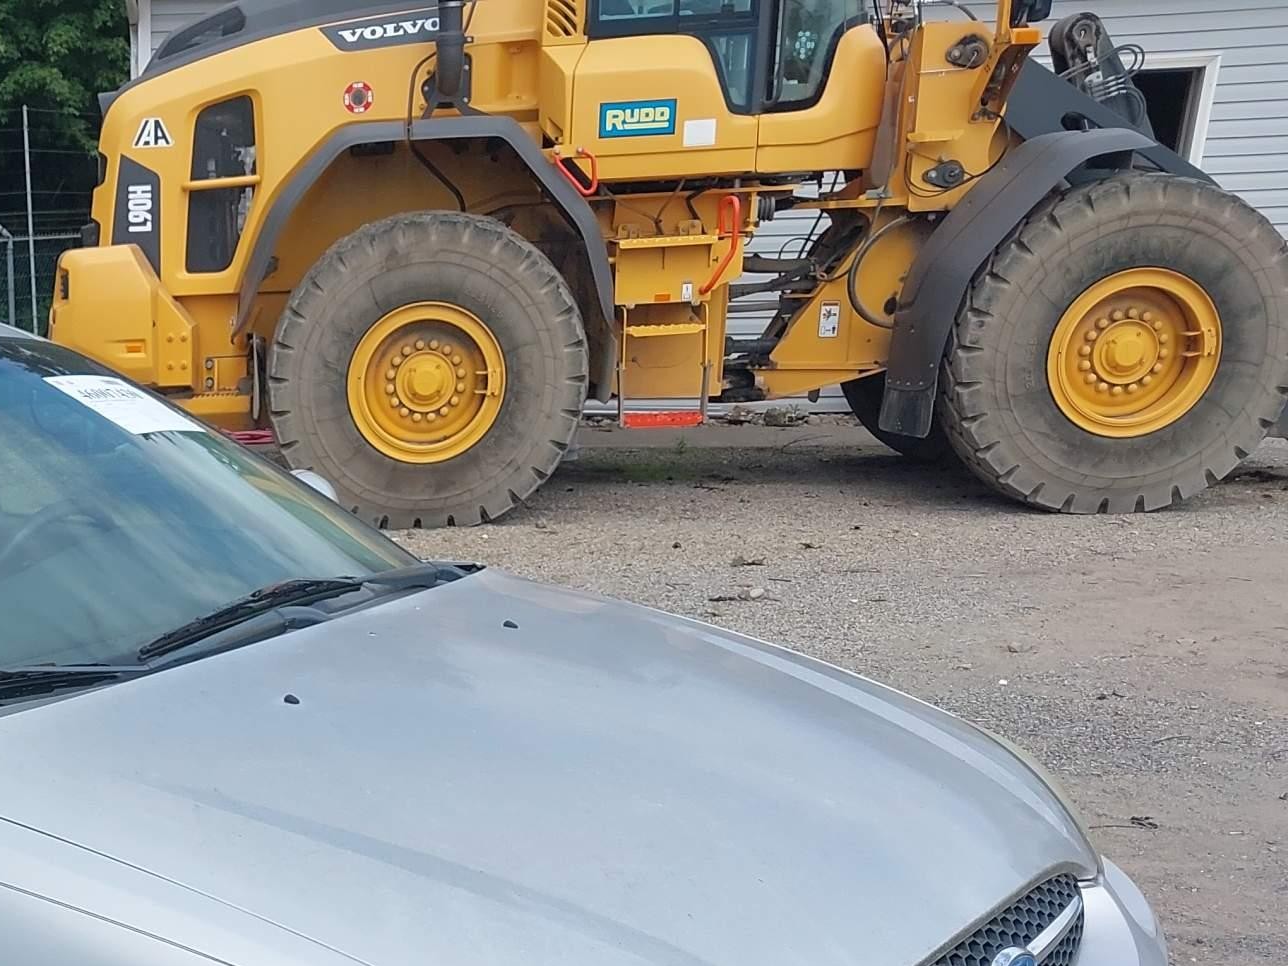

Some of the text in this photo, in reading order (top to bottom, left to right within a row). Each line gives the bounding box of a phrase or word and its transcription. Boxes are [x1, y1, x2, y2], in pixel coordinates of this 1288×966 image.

[338, 17, 440, 42] VOLVO
[605, 106, 670, 131] RUDD
[128, 184, 152, 232] L90H
